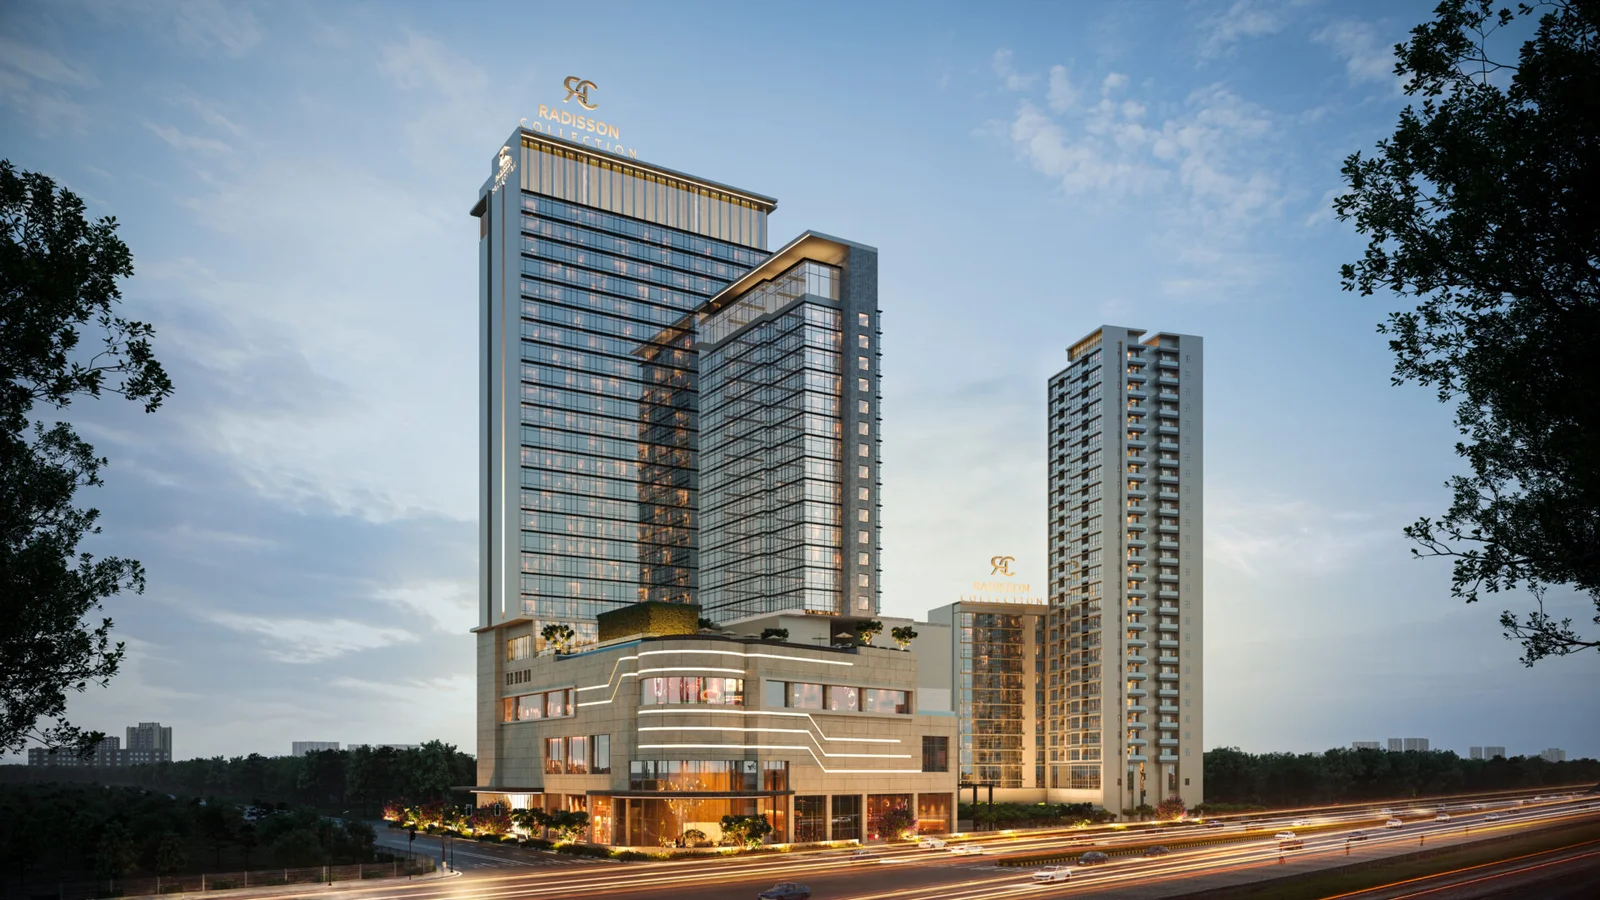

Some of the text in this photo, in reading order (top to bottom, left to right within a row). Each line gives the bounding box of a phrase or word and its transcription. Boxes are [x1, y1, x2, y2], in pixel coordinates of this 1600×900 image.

[519, 118, 637, 160] COLLECTION
[538, 104, 619, 140] RADISSON
[973, 581, 1031, 593] RADISSON
